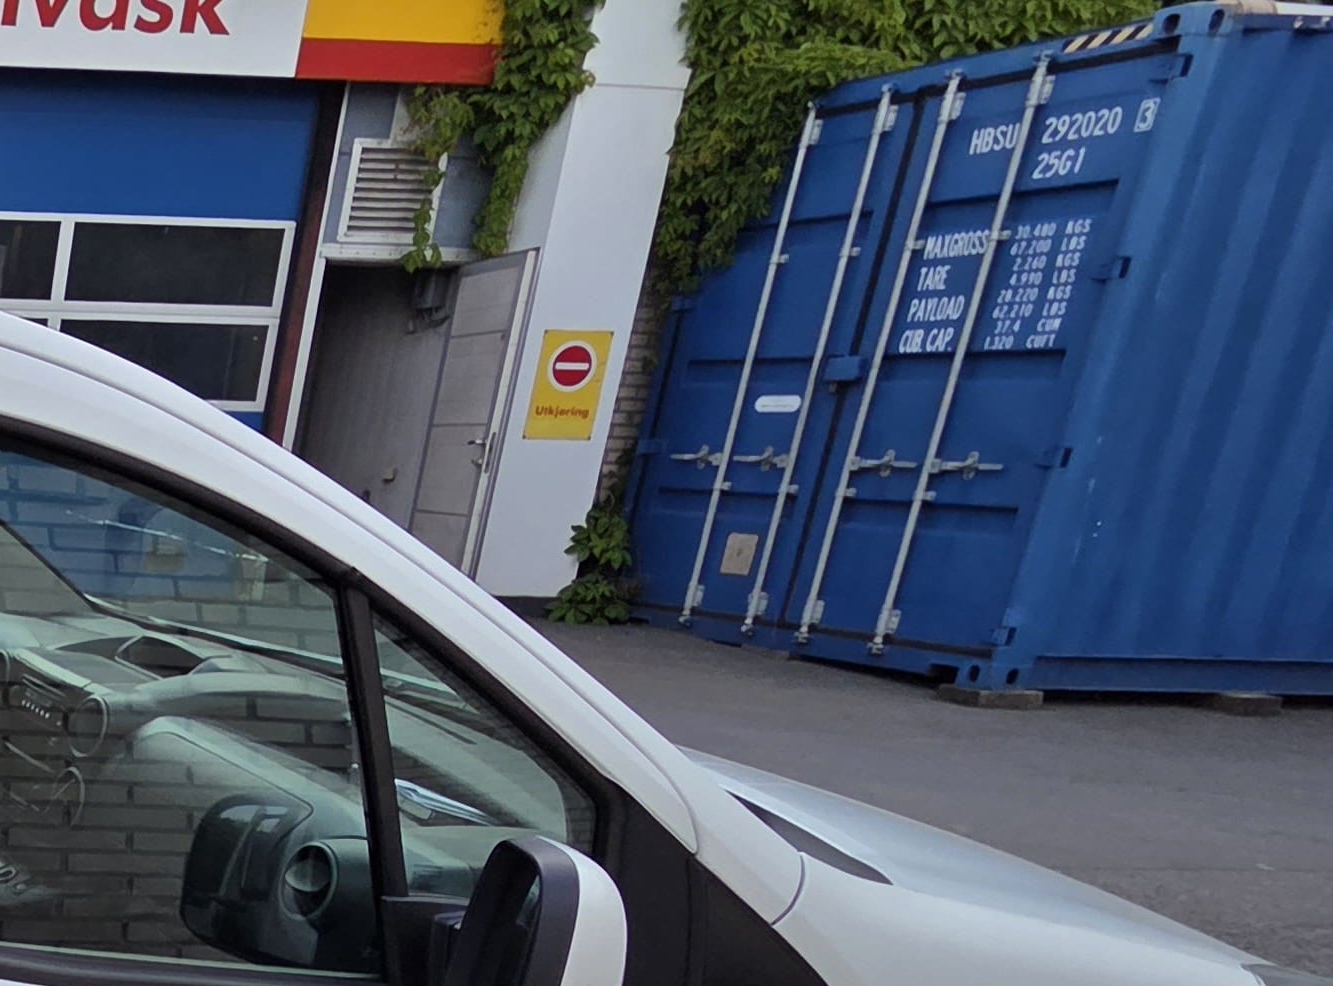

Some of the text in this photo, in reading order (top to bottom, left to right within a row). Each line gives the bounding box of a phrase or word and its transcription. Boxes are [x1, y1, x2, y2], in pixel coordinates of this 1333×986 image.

[969, 101, 1157, 155] HBSU 292020 3
[1032, 146, 1086, 180] 25G1
[923, 230, 990, 260] MAXGROSS
[1065, 218, 1092, 234] KGS
[1061, 235, 1087, 251] LBS
[917, 265, 951, 292] TARE
[1055, 252, 1081, 267] KGS
[1052, 268, 1076, 284] LBS
[906, 295, 965, 322] PAYLOAD
[1047, 284, 1072, 300] KGS
[1042, 301, 1067, 316] LBS
